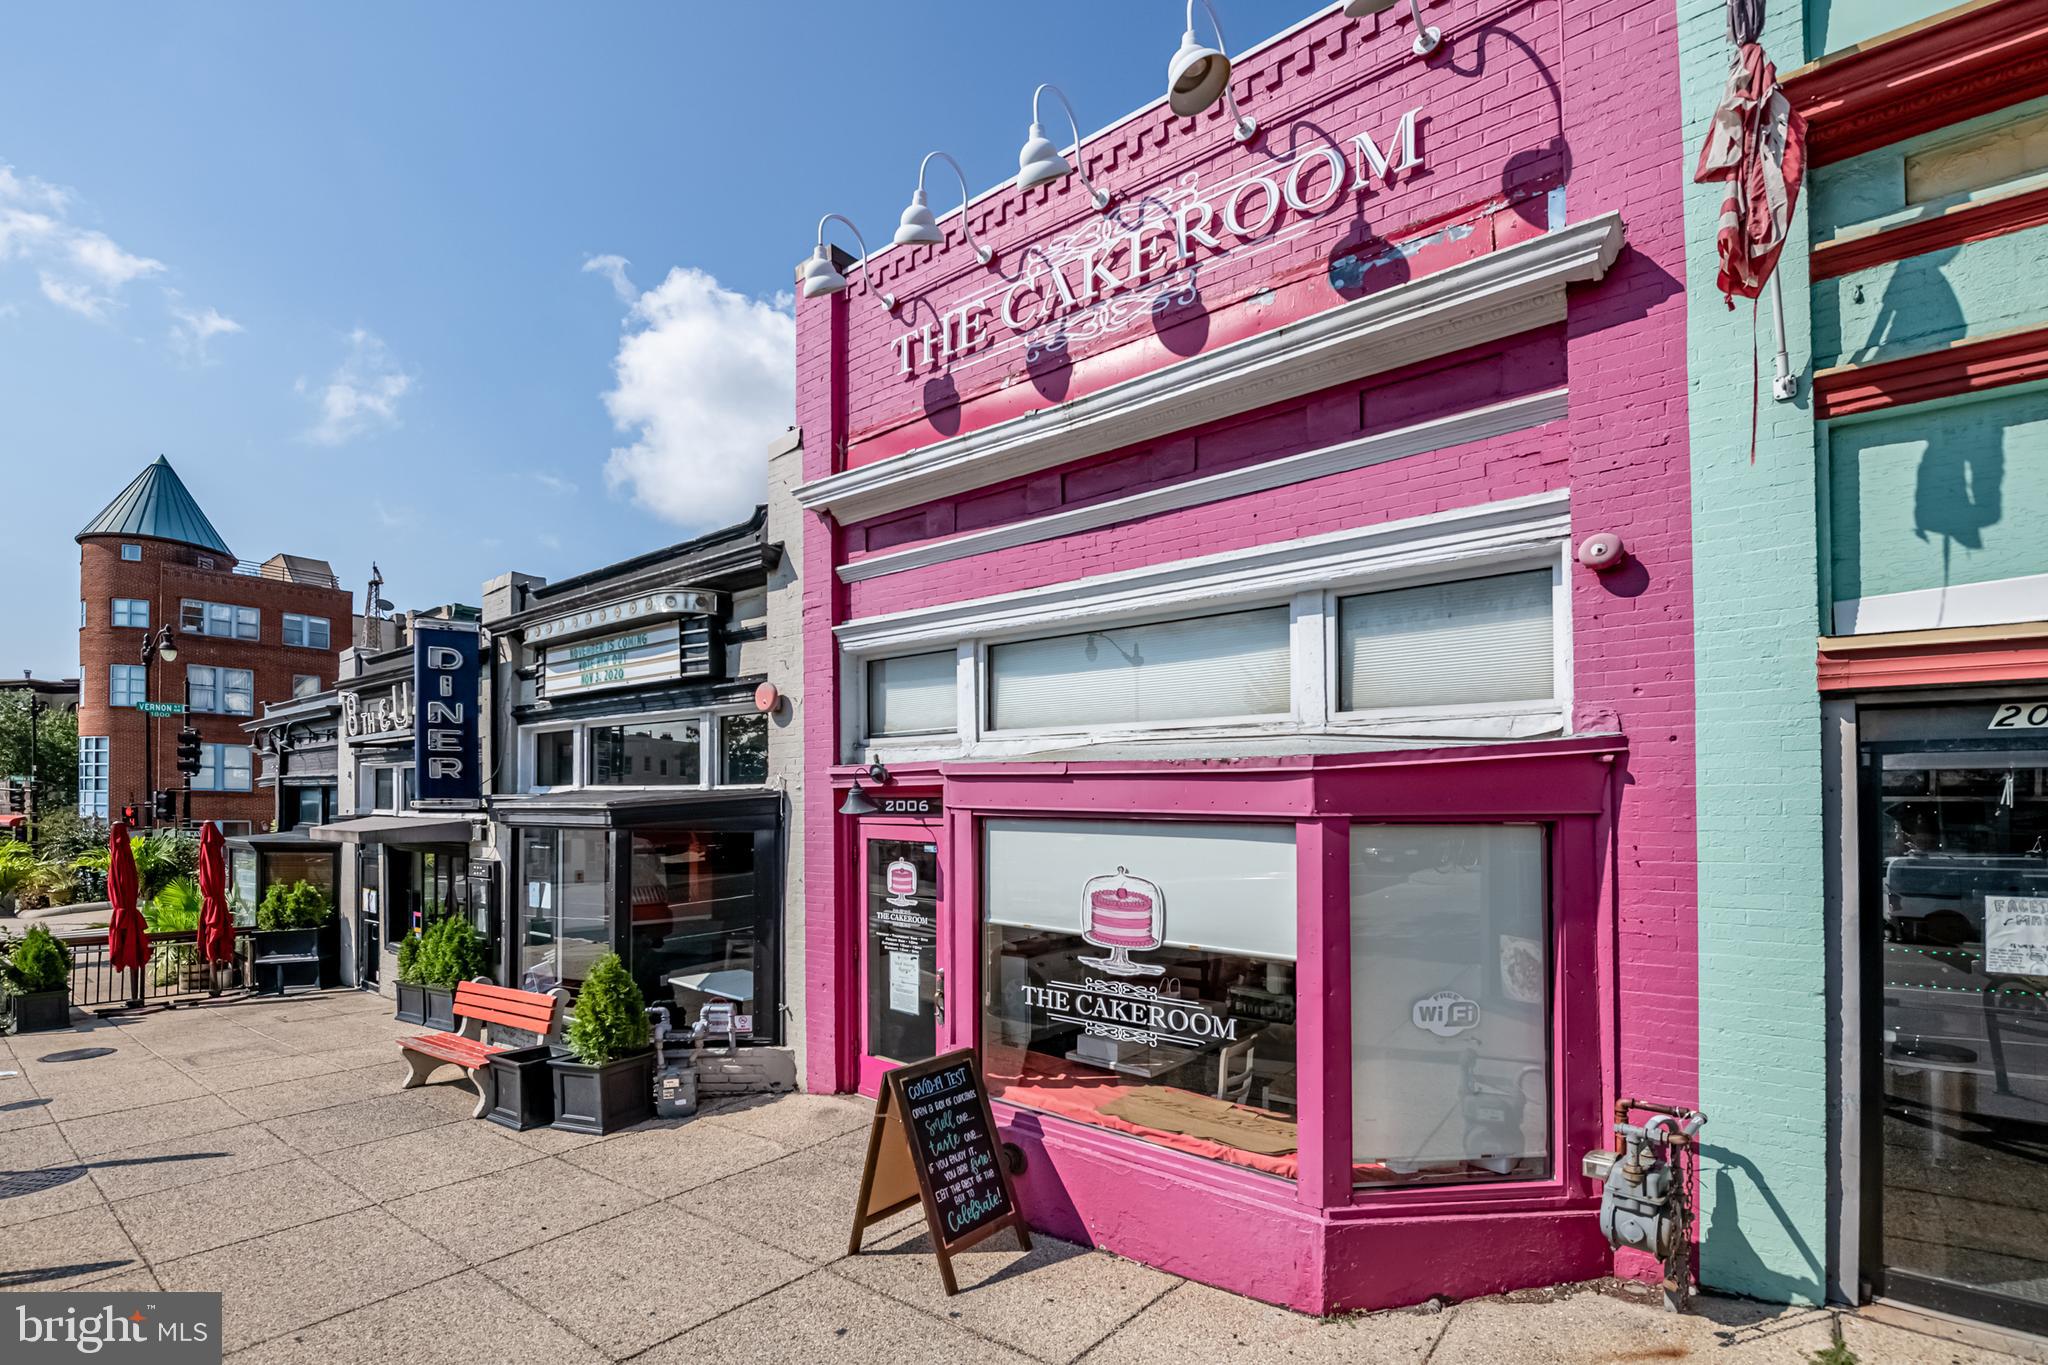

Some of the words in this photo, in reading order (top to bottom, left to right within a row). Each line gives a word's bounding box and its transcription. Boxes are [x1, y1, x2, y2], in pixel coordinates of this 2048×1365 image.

[891, 300, 991, 376] THE
[999, 106, 1424, 331] CAKEROOM
[617, 633, 648, 649] COMING
[604, 669, 625, 681] 2020
[139, 703, 172, 712] VERNON
[427, 645, 464, 779] DINER
[885, 800, 929, 811] 2006
[876, 911, 890, 920] THE
[890, 913, 928, 925] CAKEROOM
[1021, 985, 1070, 1011] THE
[1075, 994, 1237, 1040] CAKEROOM
[908, 1076, 943, 1099] COVID-19
[944, 1068, 966, 1086] TEST
